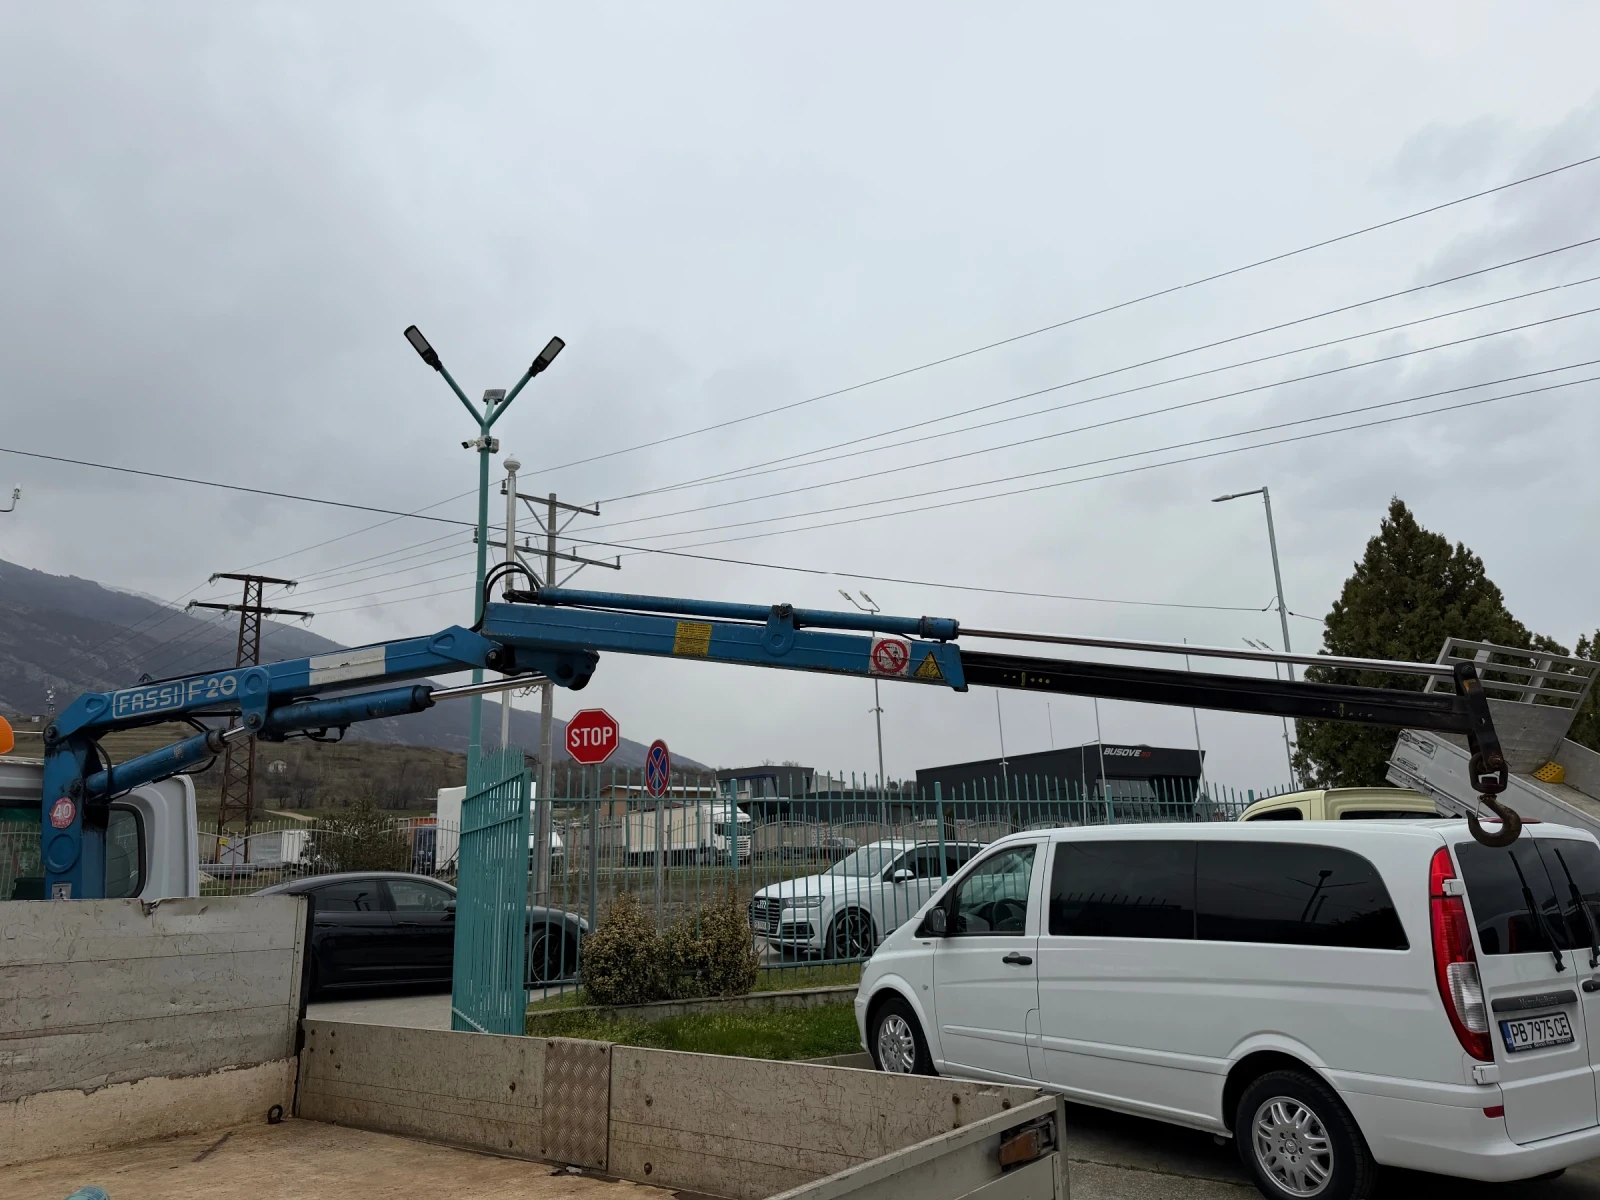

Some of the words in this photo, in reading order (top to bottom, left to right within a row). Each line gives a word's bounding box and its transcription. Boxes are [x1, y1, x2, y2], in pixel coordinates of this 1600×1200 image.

[119, 686, 178, 713] FASSI
[571, 727, 613, 747] STOP
[53, 803, 72, 819] 40
[1510, 1021, 1528, 1043] PB
[1527, 1019, 1555, 1041] 7975
[1553, 1017, 1570, 1037] CE
